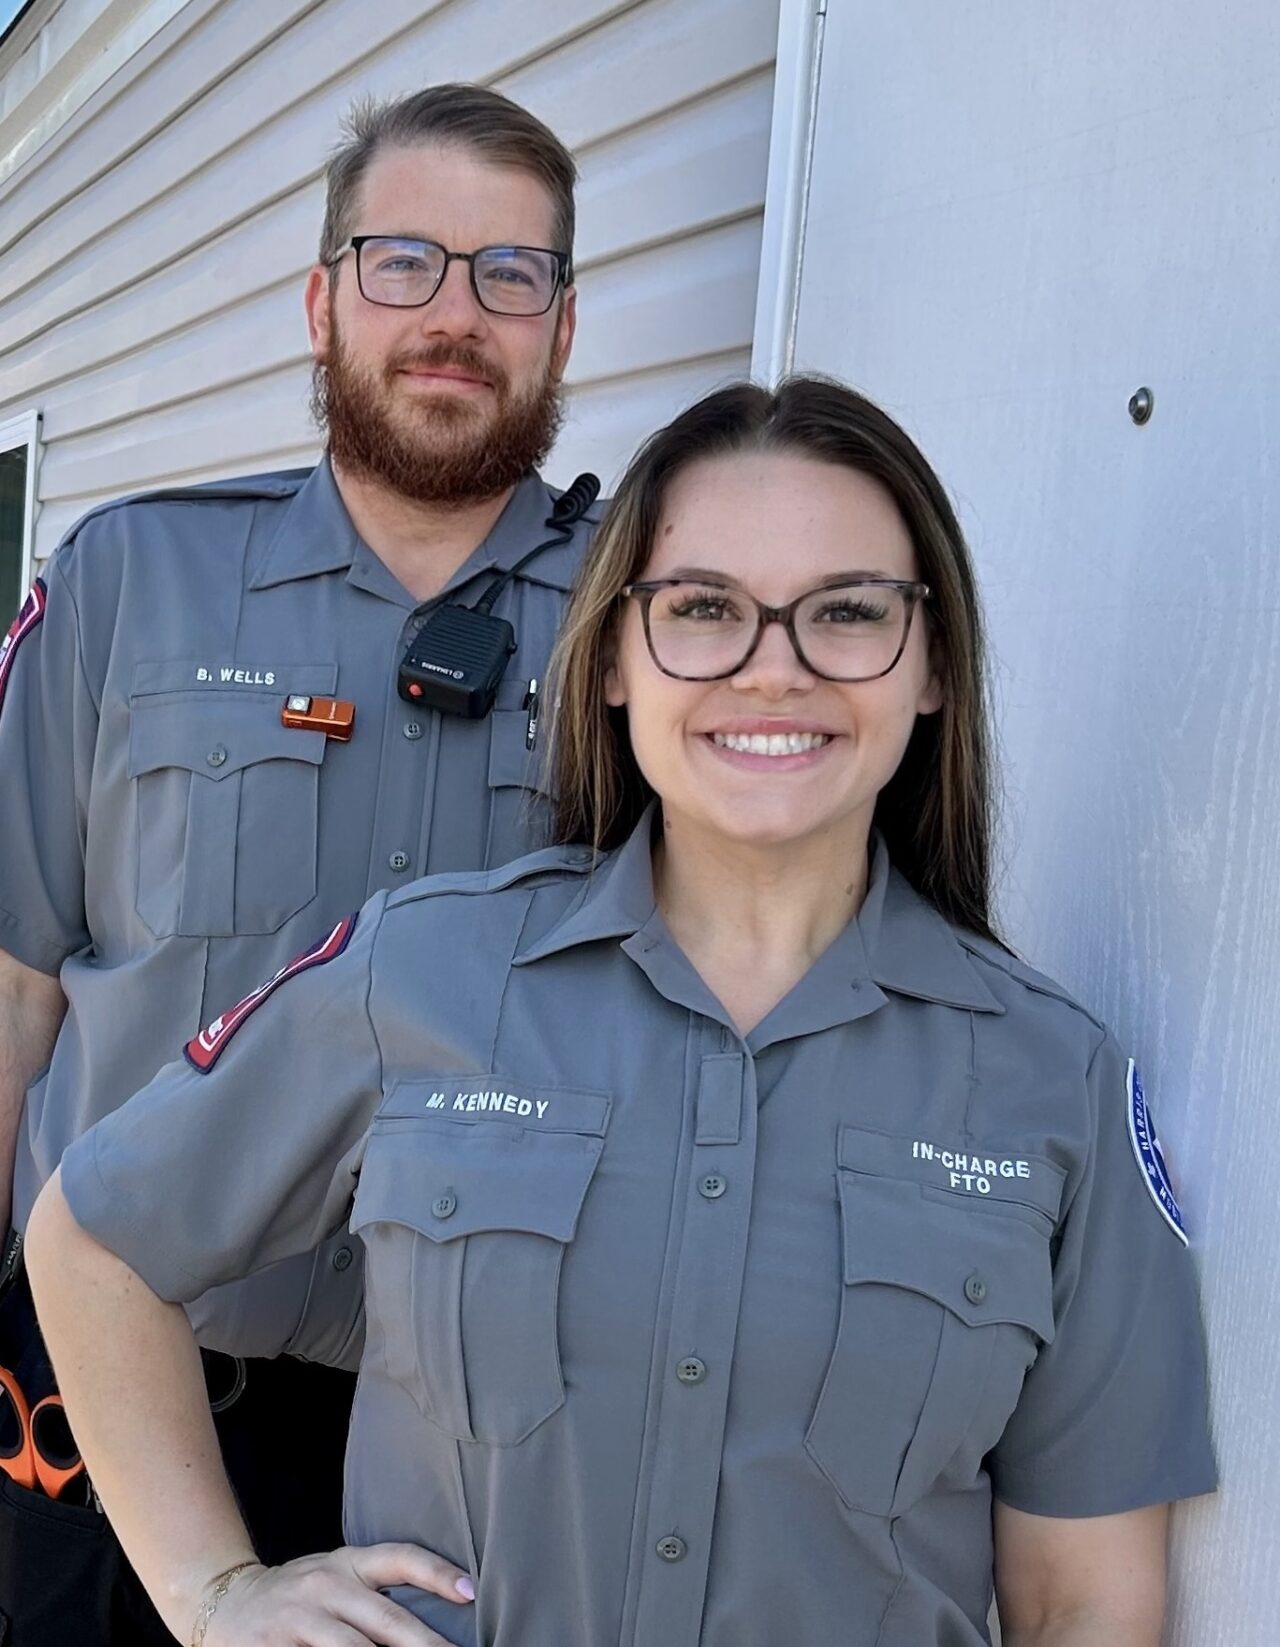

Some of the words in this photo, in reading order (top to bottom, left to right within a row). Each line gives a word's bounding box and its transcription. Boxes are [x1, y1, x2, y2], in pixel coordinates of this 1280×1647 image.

[220, 668, 275, 686] WELLS
[452, 1091, 549, 1119] KENNEDY
[912, 1141, 1030, 1179] IN-CHARGE
[949, 1172, 991, 1194] FTO
